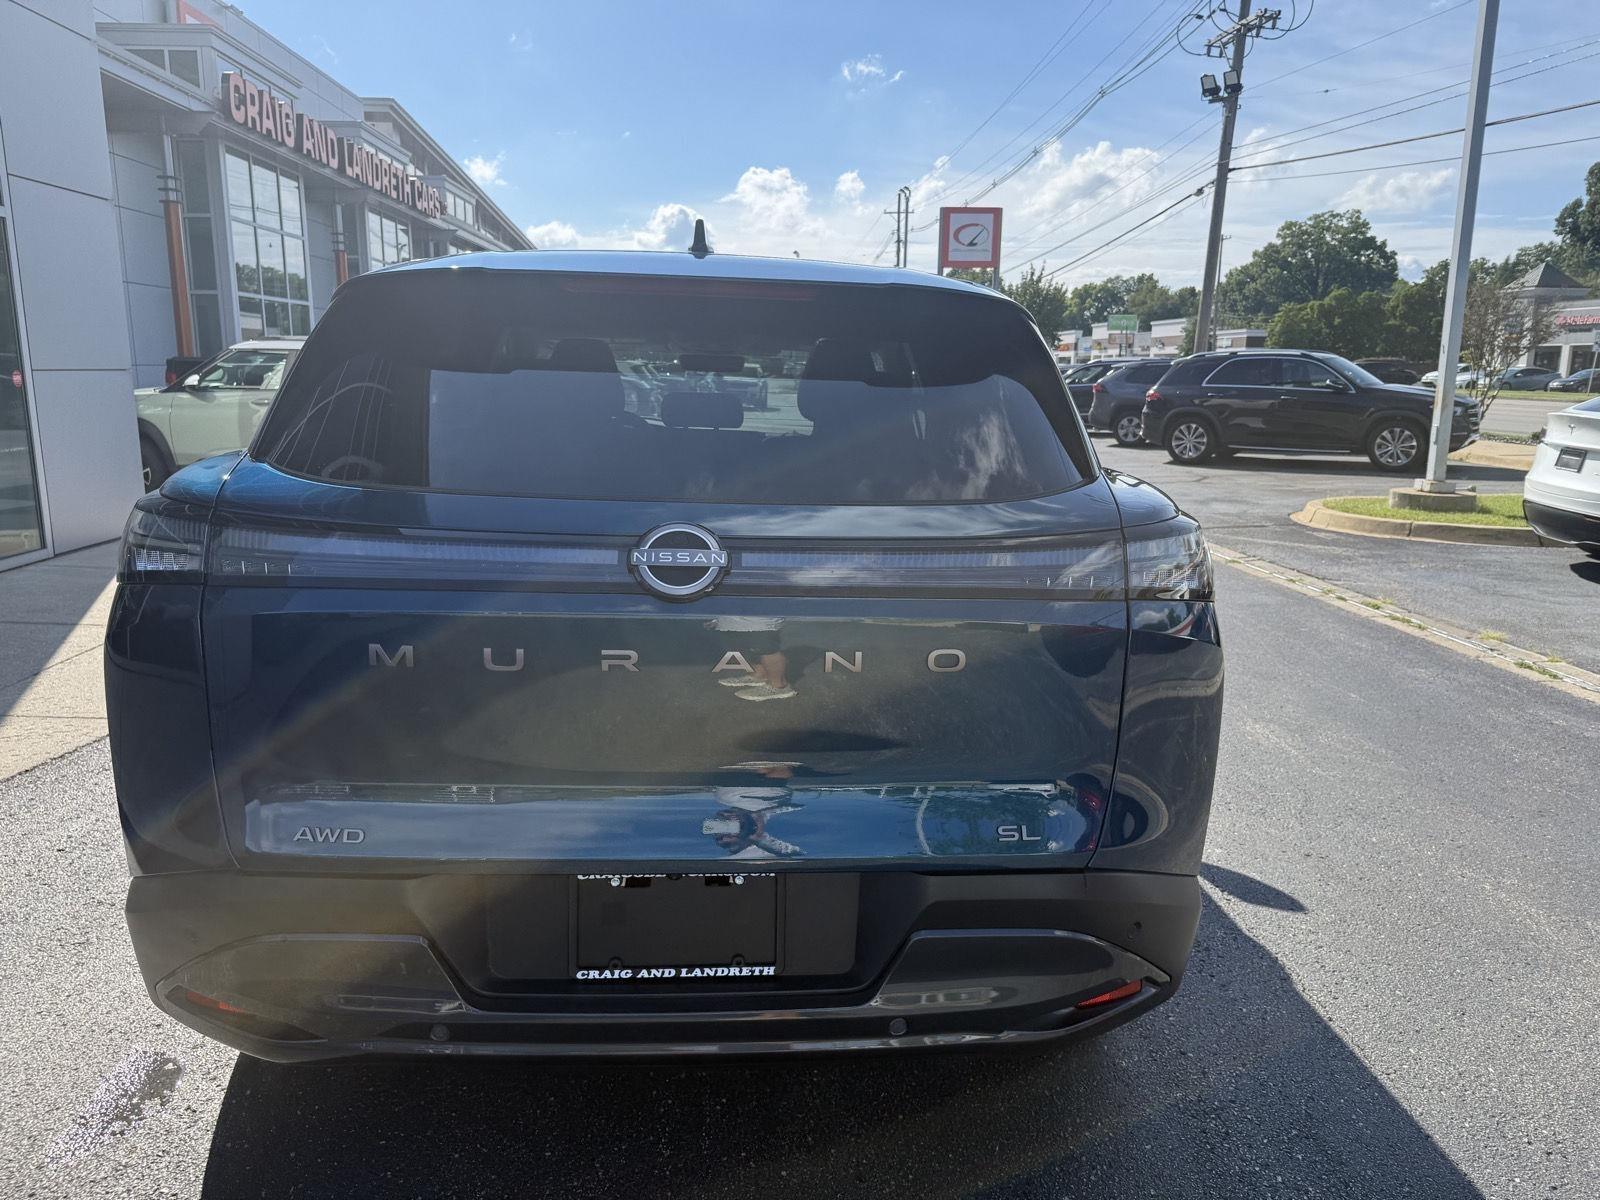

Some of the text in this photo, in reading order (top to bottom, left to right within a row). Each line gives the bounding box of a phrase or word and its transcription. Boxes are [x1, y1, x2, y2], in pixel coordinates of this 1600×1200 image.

[227, 72, 441, 219] CRAIG AND LANDRETH CARS
[633, 552, 725, 564] NISSAN
[367, 642, 967, 673] MURANO
[293, 826, 365, 844] AWD
[997, 824, 1042, 842] SL
[575, 966, 776, 980] CRAIG AND LANDRETH
